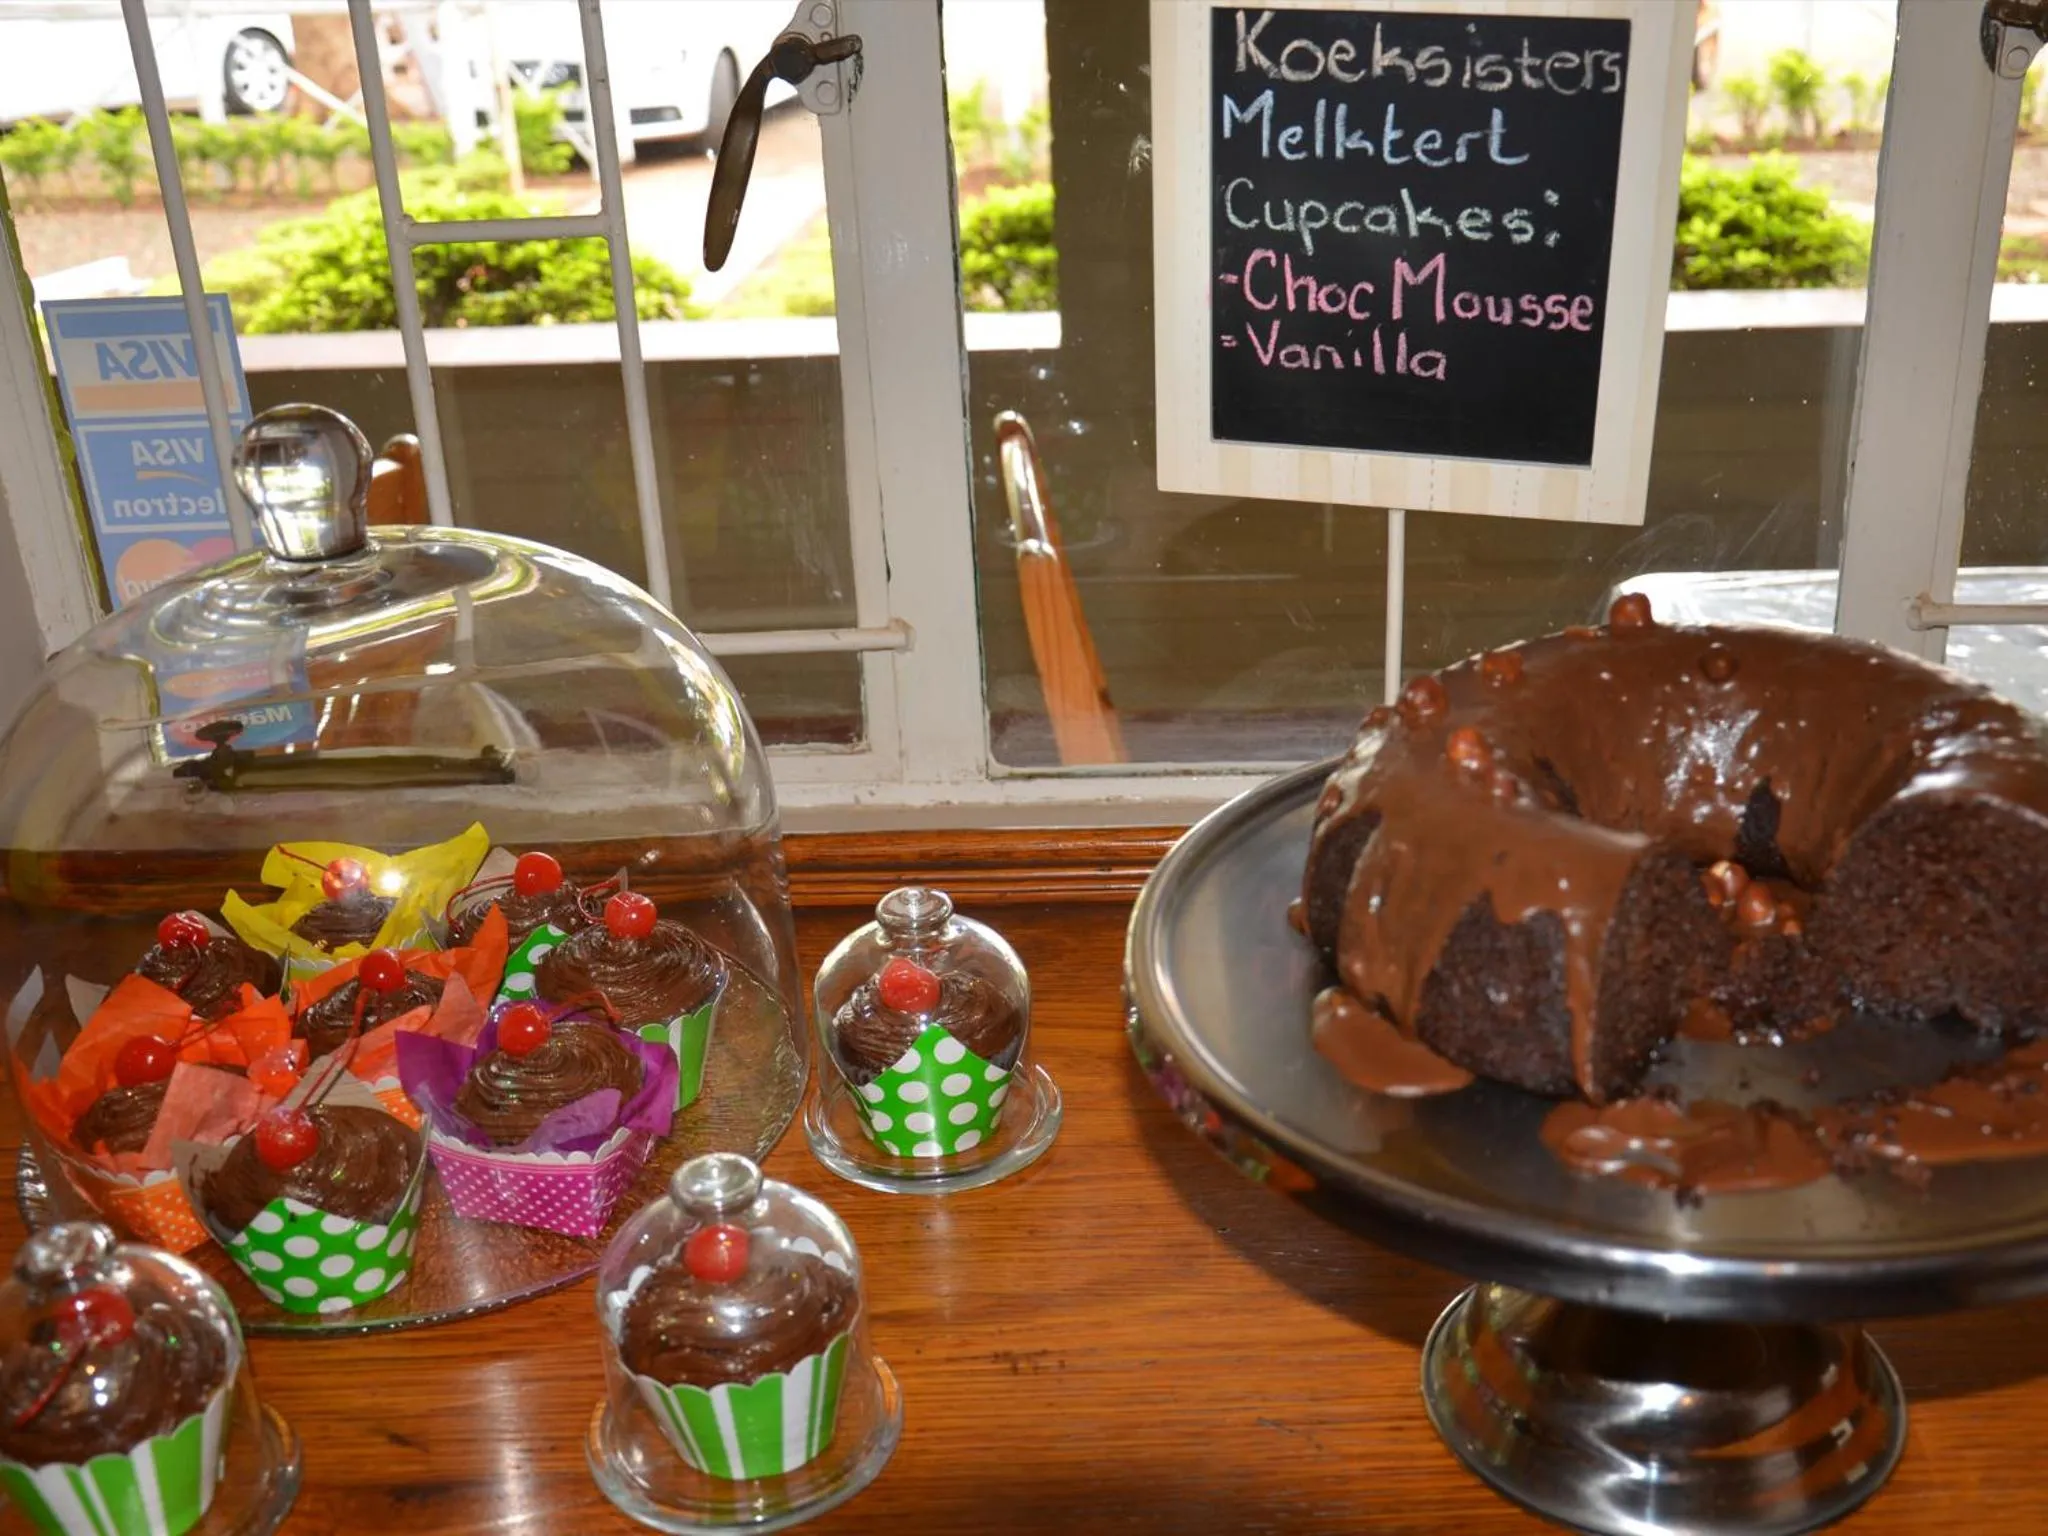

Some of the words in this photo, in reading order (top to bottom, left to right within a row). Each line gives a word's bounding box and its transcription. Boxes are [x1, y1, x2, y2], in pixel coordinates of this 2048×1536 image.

[1235, 10, 1623, 95] Koeksisters
[1223, 89, 1530, 167] Melktert
[1224, 177, 1561, 256] Cupcakes:
[1392, 252, 1595, 331] Mousse
